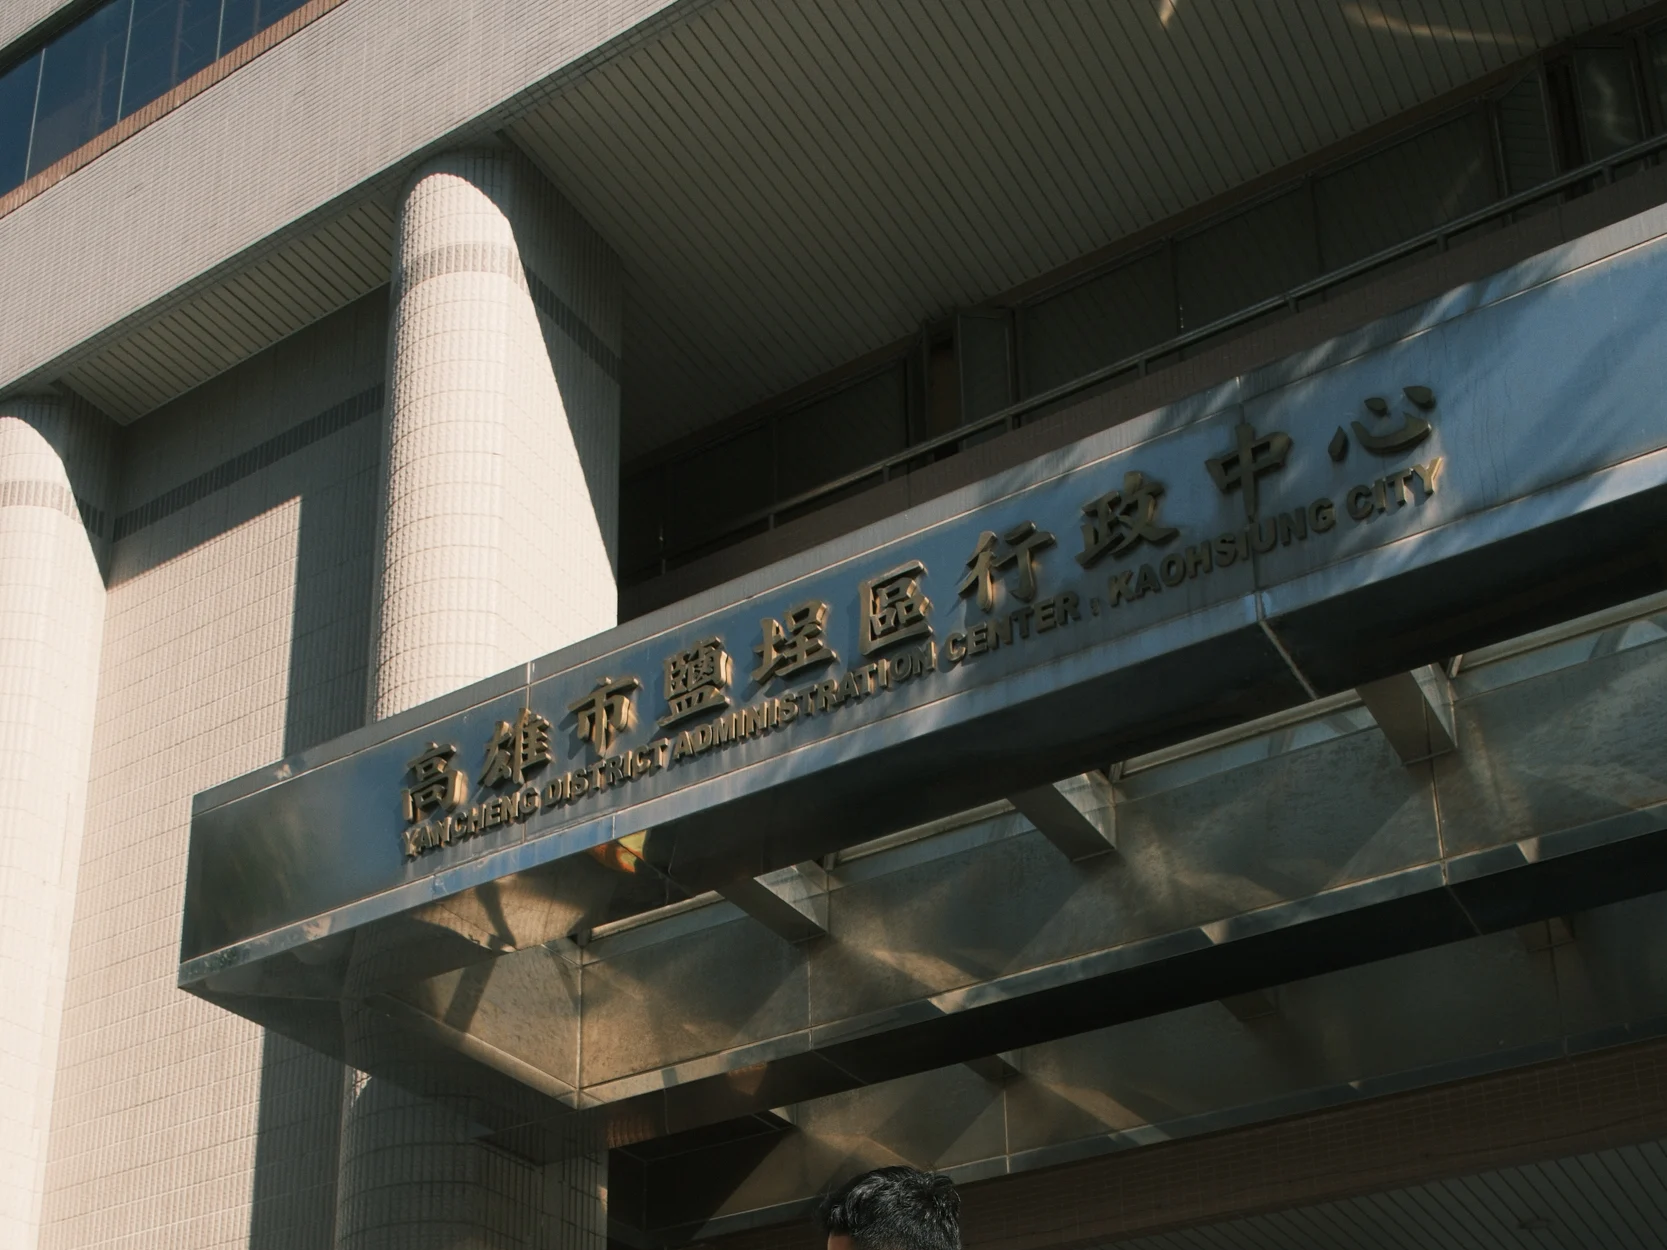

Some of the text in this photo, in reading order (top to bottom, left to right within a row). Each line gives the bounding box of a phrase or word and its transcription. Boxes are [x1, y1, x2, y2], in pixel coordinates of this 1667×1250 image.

[402, 385, 1436, 822] 高雄市鹽埕區行政中心
[402, 786, 541, 857] YANCHENG
[545, 737, 669, 806] DISTRICT
[674, 641, 937, 761] ADMINISTRATION
[1108, 497, 1336, 607] KAOHSIUNG
[1346, 457, 1442, 521] CITY
